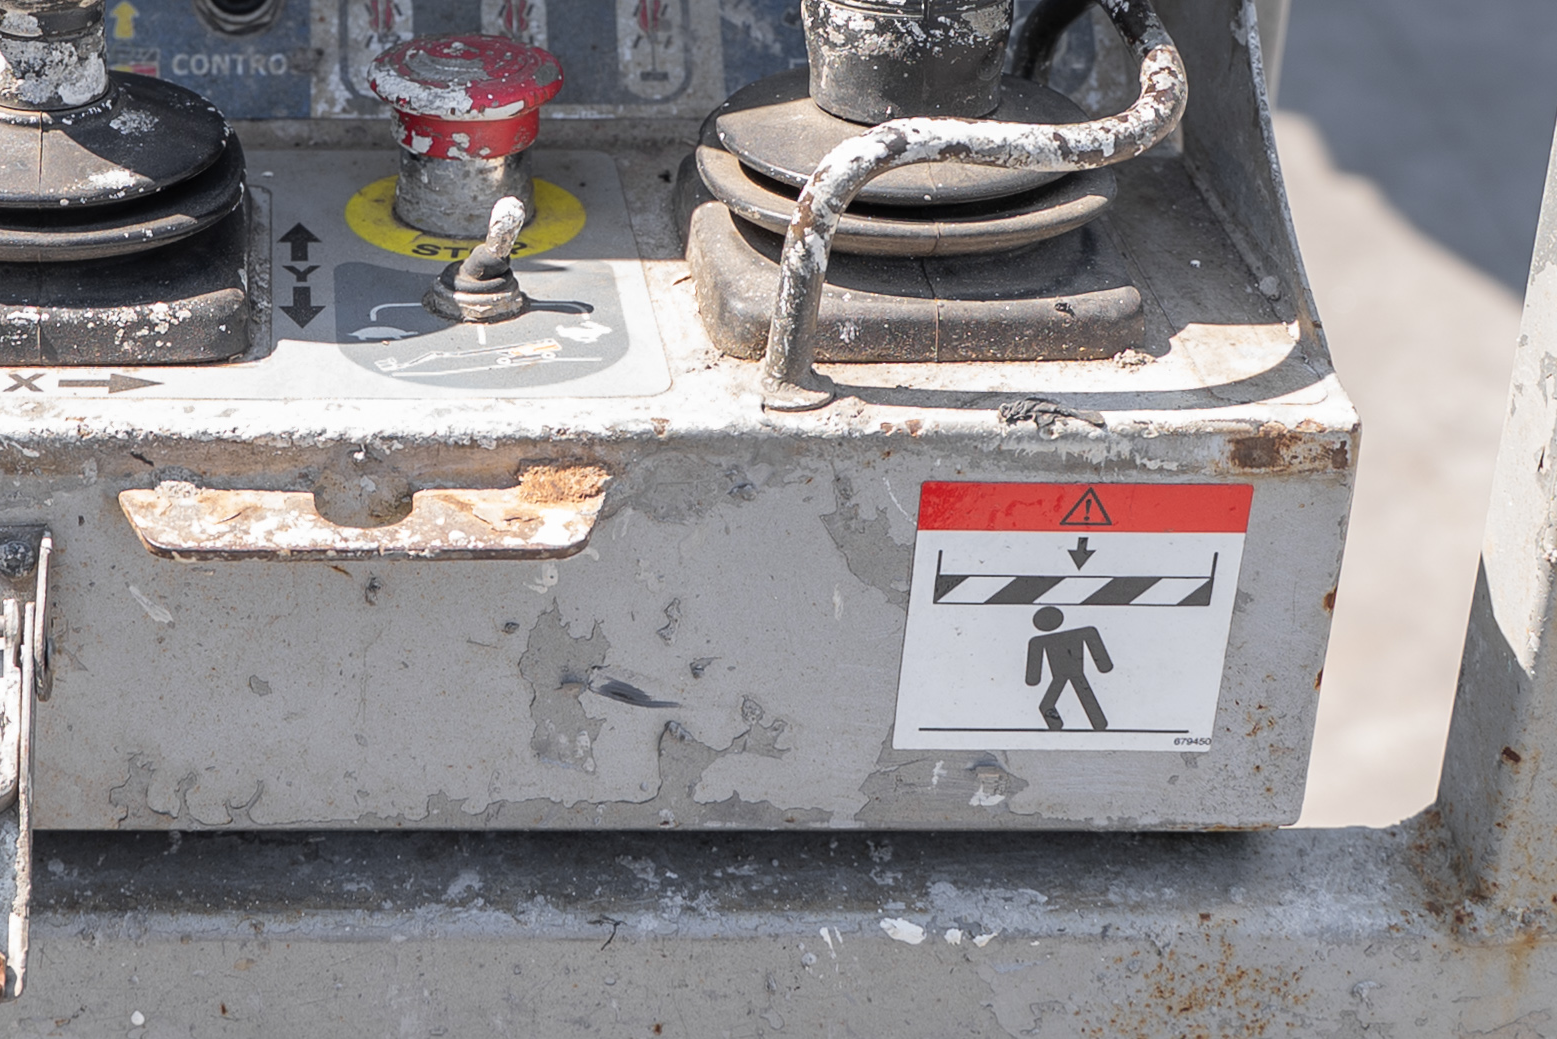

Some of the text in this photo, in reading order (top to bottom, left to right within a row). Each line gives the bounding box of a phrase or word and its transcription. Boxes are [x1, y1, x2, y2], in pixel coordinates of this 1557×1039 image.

[171, 52, 304, 76] CONTRO
[282, 264, 321, 282] Y
[3, 373, 46, 392] X
[1173, 737, 1212, 746] 679450
